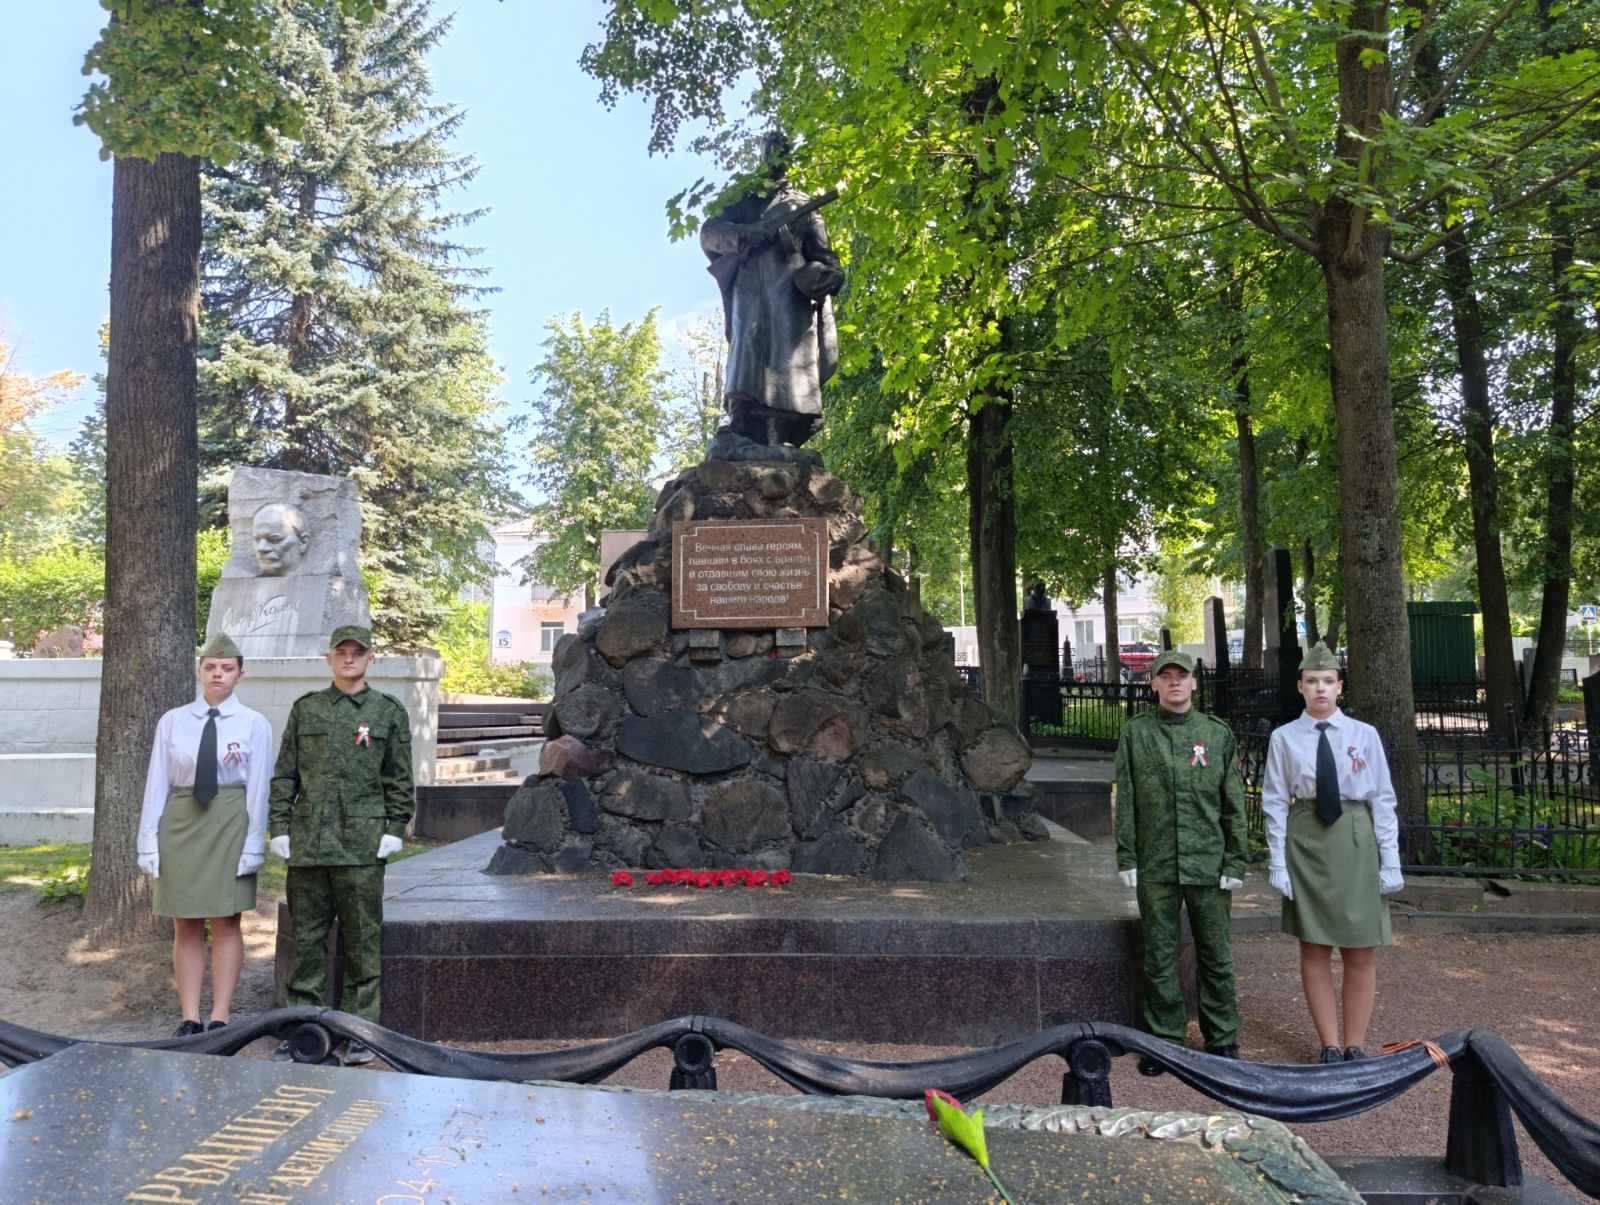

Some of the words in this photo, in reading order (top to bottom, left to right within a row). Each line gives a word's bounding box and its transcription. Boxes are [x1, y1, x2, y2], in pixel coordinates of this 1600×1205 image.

[740, 555, 763, 564] боях
[688, 570, 696, 578] и
[698, 569, 749, 578] отдавшим
[751, 568, 777, 577] свою
[778, 568, 810, 577] жизнь
[696, 583, 708, 592] за
[710, 581, 752, 592] свободу
[753, 582, 761, 590] и
[763, 581, 802, 590] счастье
[124, 1084, 336, 1205] РВАШЕНЯ
